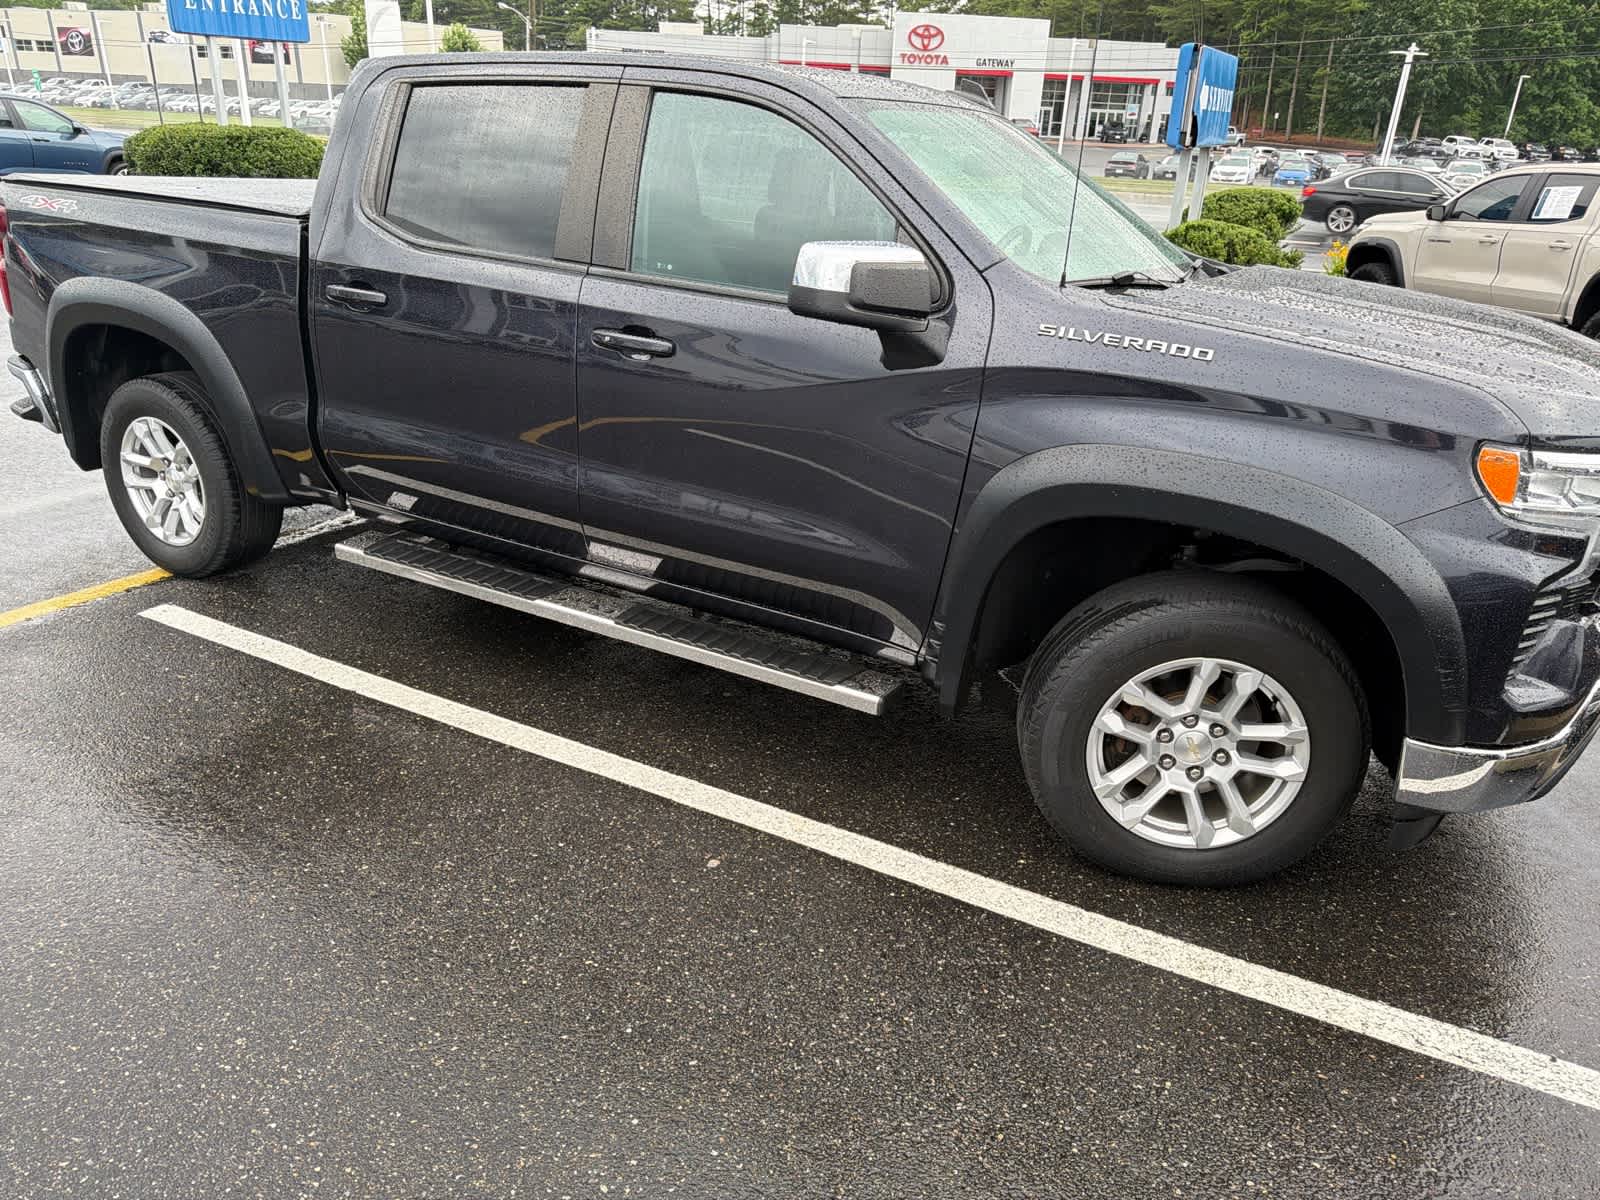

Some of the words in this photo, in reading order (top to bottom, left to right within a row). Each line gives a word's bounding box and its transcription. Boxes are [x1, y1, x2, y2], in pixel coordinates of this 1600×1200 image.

[900, 53, 949, 65] TOYOTA
[976, 58, 1015, 68] GATEWAY
[1037, 323, 1215, 361] SILVERADO
